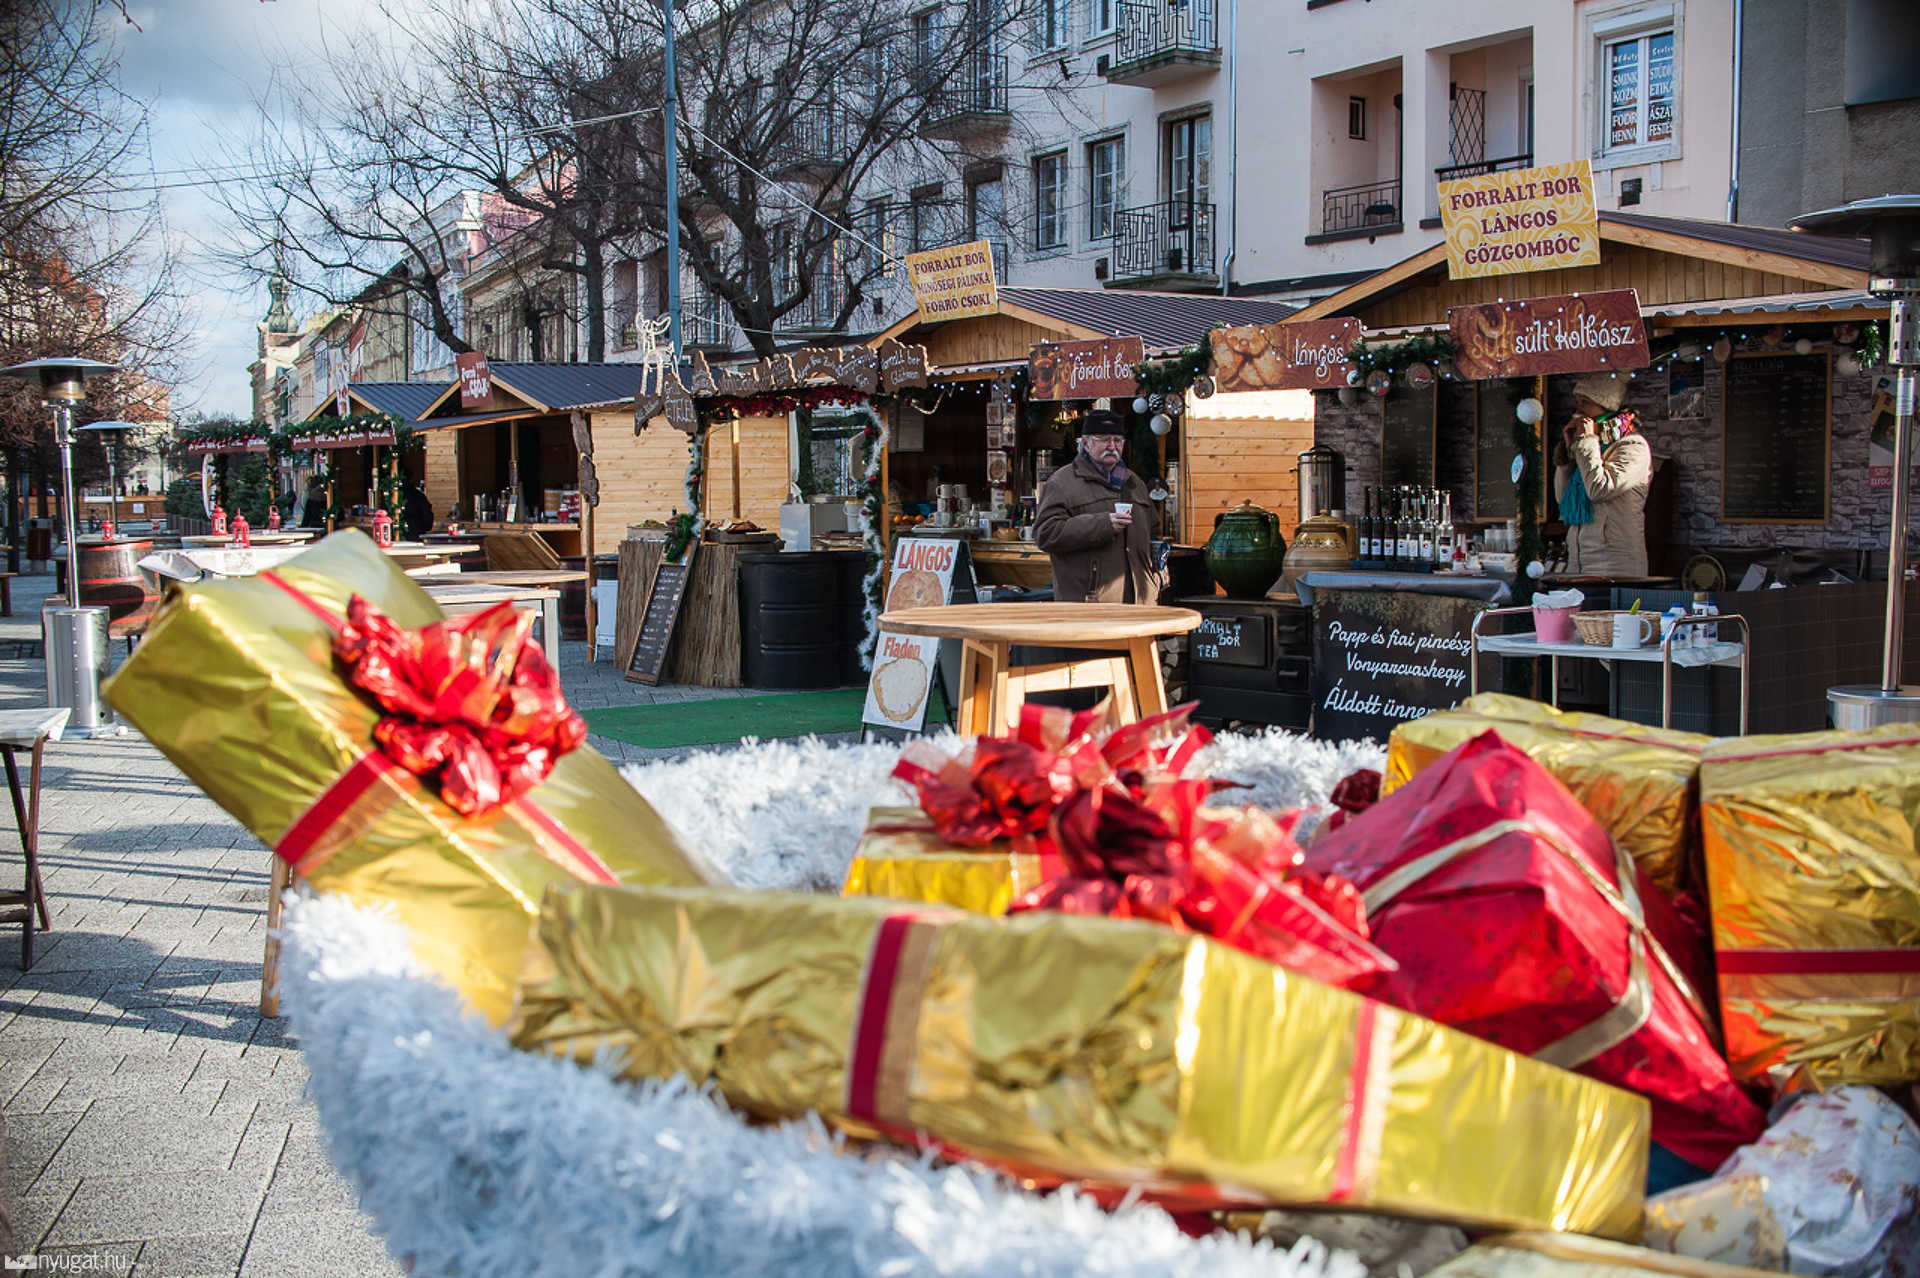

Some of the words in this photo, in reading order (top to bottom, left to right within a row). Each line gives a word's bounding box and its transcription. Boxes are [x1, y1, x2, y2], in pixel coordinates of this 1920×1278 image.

[1451, 183, 1536, 210] FORRALT
[1542, 177, 1581, 197] BOR
[1481, 210, 1557, 234] LÁNGOS
[913, 256, 962, 275] FORRALT
[964, 252, 986, 266] BOR
[1465, 233, 1580, 264] GŐZGOMBÓC
[957, 272, 991, 288] PÁLINKA
[961, 293, 991, 308] CSOKI
[1515, 320, 1550, 354] sült
[1555, 314, 1636, 350] kolbász
[1070, 356, 1111, 389] forralt
[1295, 338, 1344, 377] lángos
[898, 541, 953, 572] LÁNGOS
[883, 637, 921, 659] Fladen
[1197, 644, 1219, 658] TEA
[1217, 634, 1240, 647] BOR
[1329, 621, 1369, 648] Papp
[1371, 626, 1385, 645] és
[1387, 629, 1416, 648] fiai
[1414, 632, 1473, 656] pincész
[1324, 678, 1382, 715] Áldott
